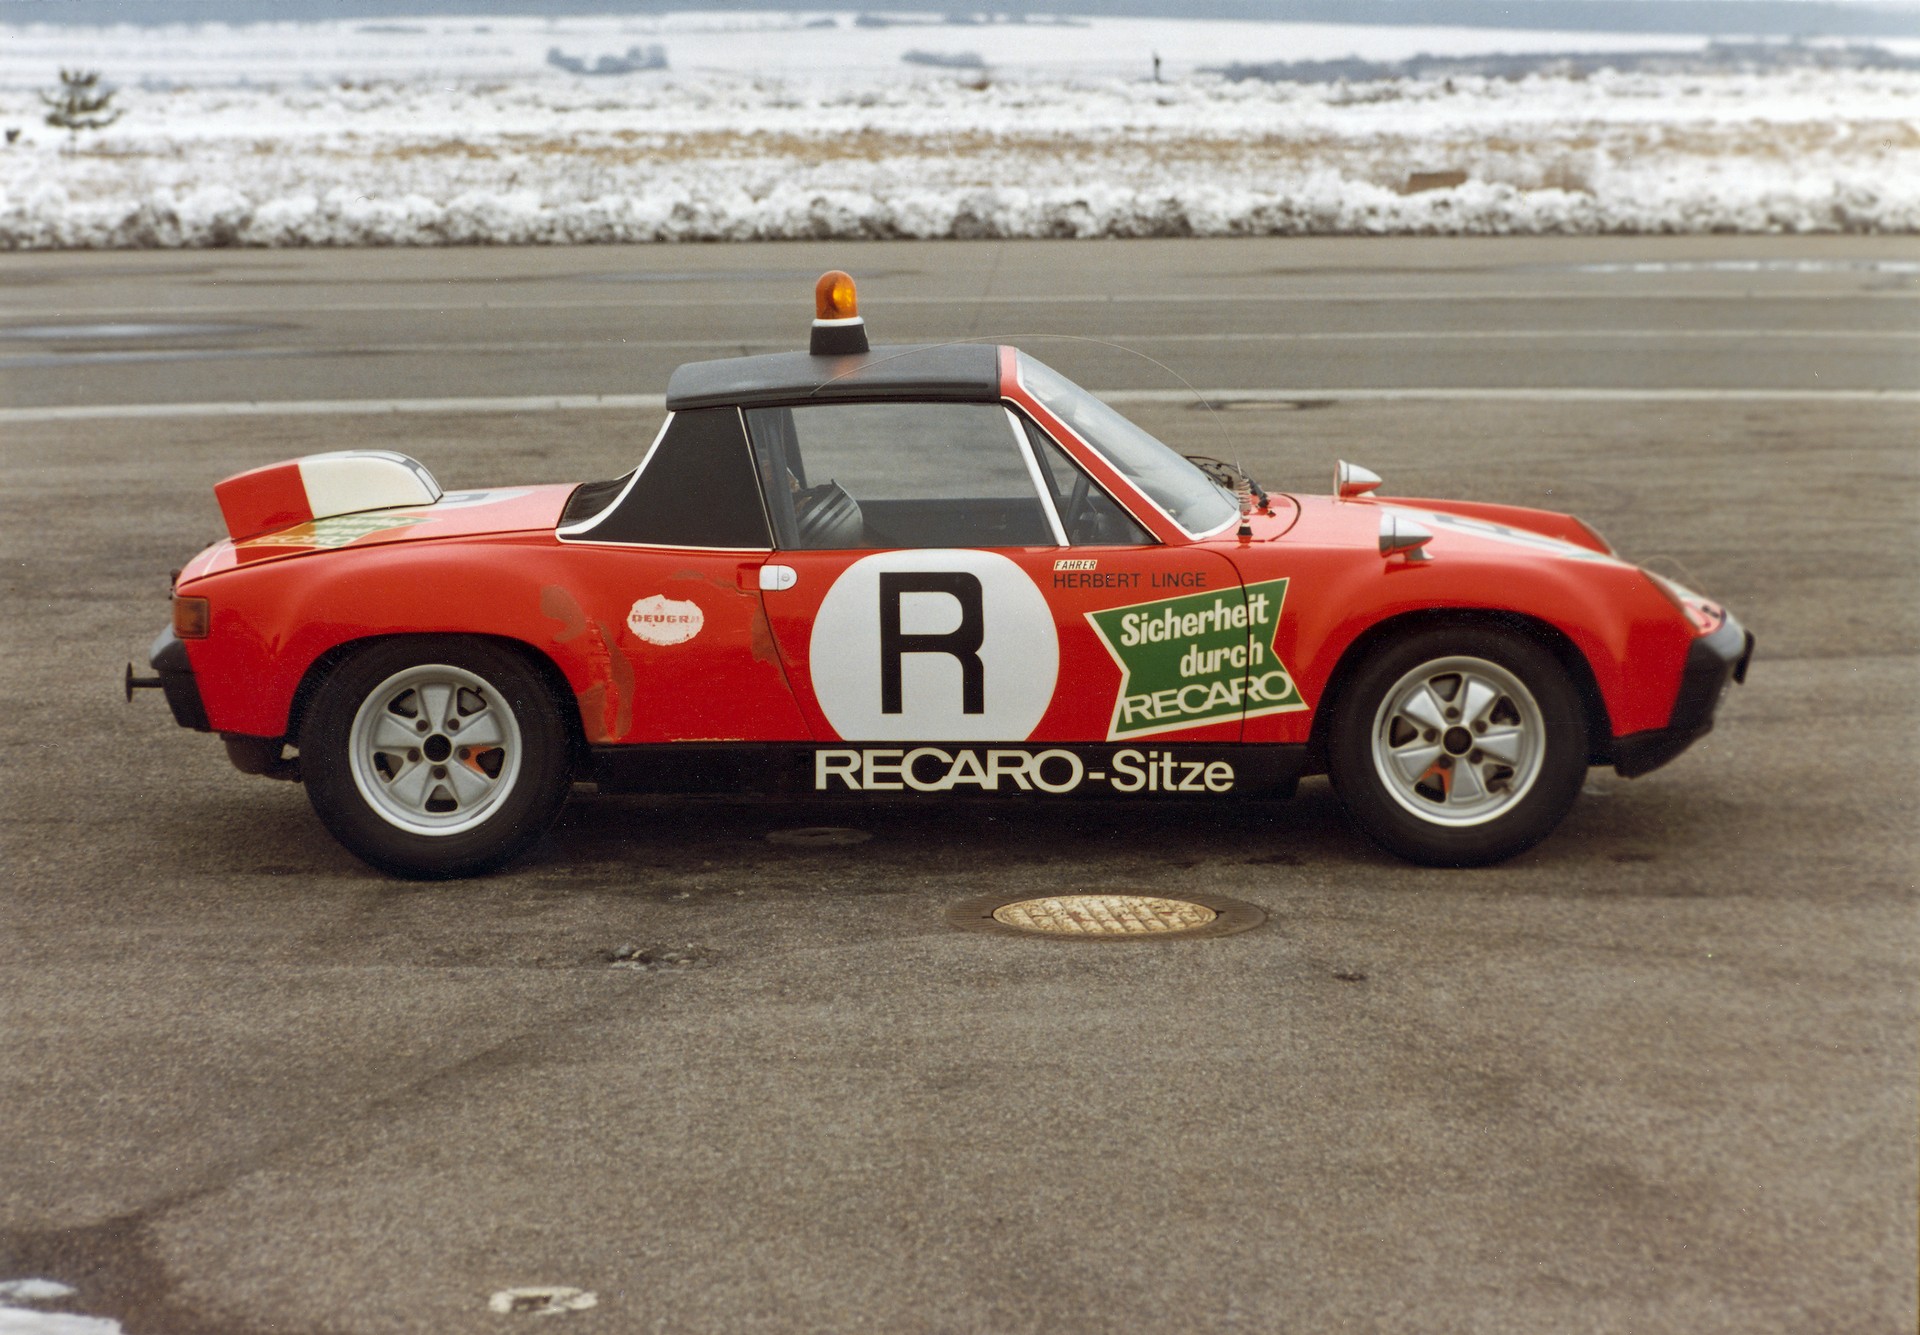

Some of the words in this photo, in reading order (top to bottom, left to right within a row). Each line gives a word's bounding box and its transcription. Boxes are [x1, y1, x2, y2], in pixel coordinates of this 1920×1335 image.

[1053, 573, 1141, 588] HERBERT
[1152, 572, 1207, 588] LINGE
[1054, 560, 1096, 570] FAHRER
[879, 571, 985, 715] R
[1120, 593, 1270, 647] Sicherheit
[1180, 634, 1264, 678] durch
[1121, 670, 1294, 724] RECARO
